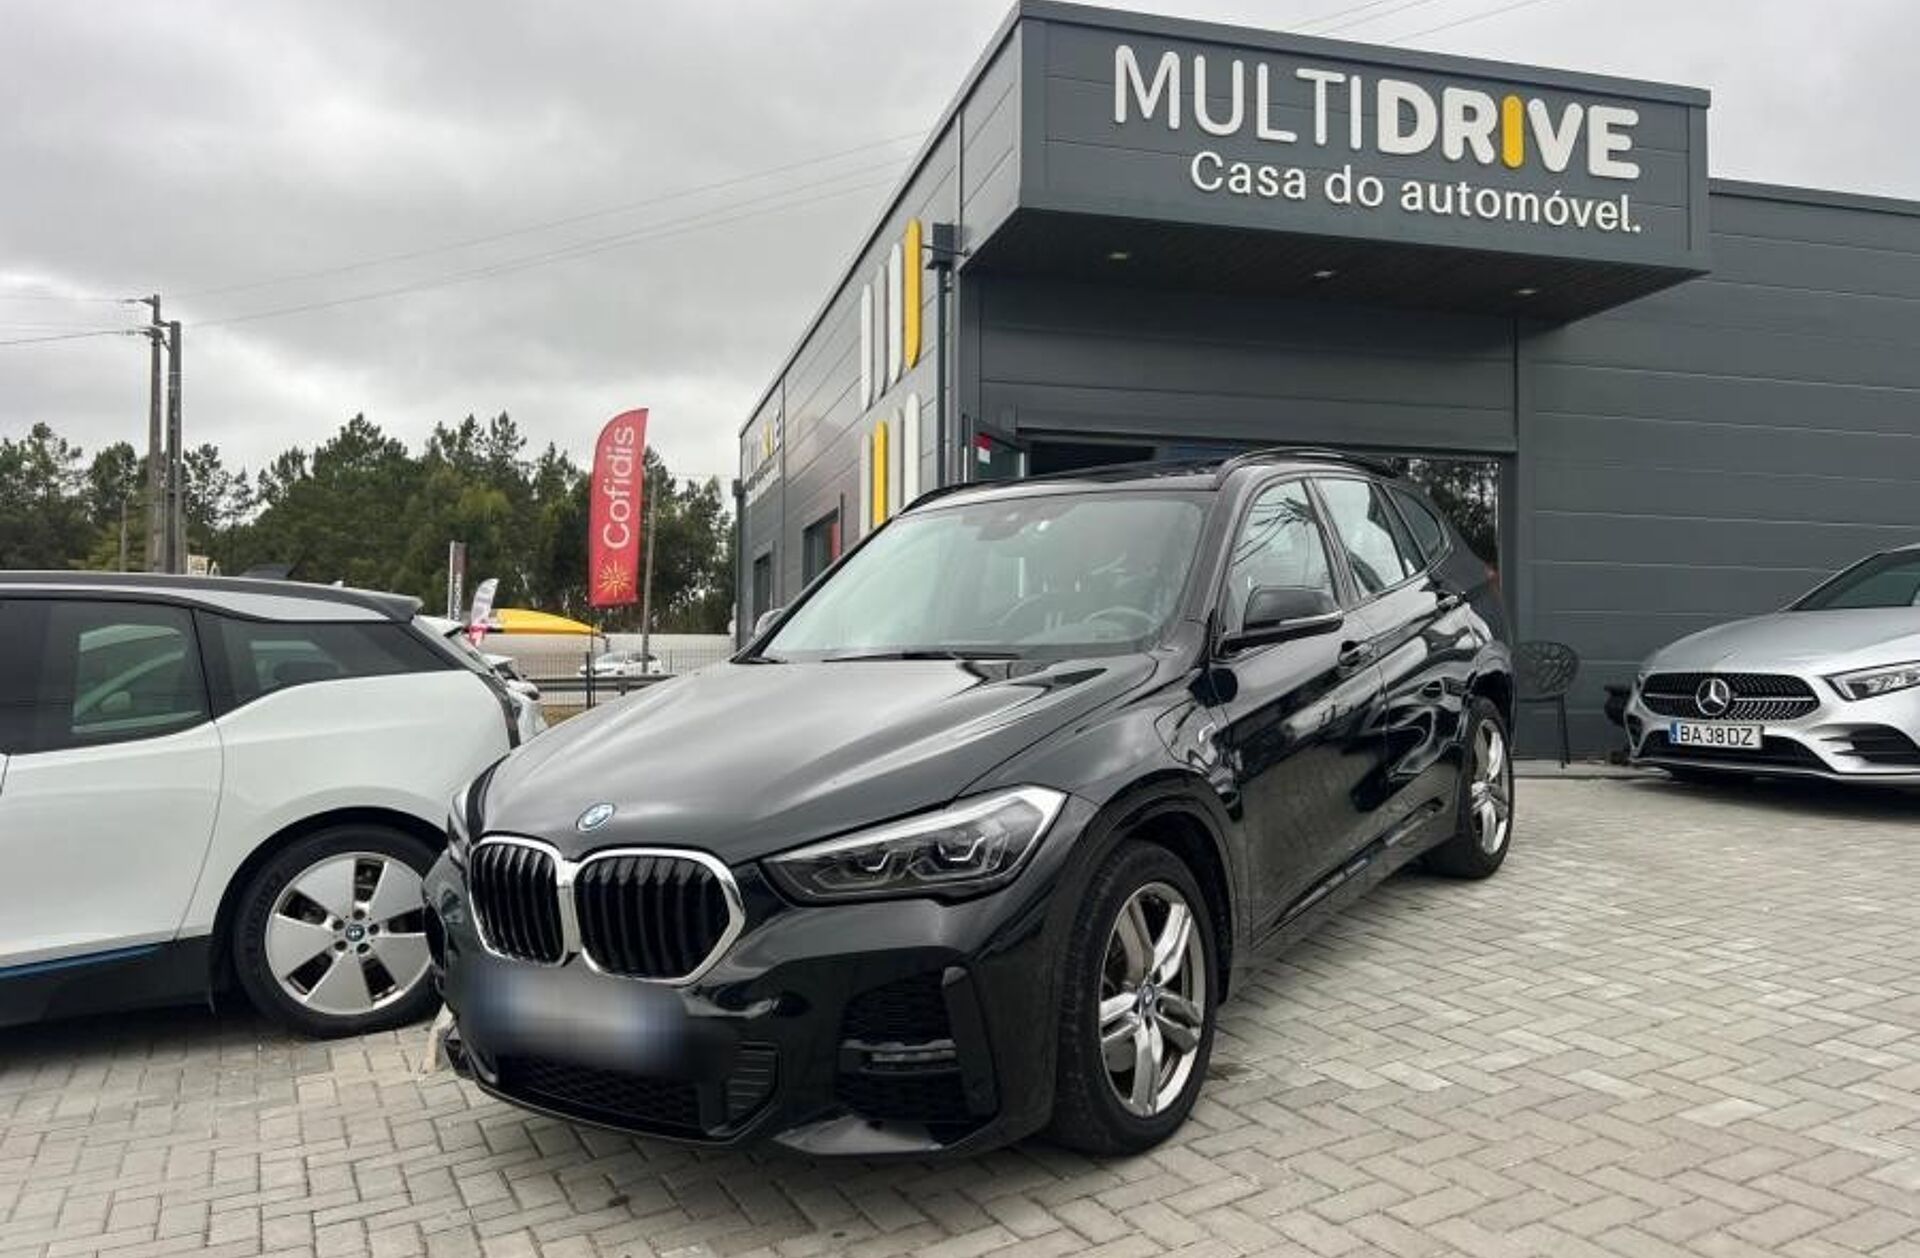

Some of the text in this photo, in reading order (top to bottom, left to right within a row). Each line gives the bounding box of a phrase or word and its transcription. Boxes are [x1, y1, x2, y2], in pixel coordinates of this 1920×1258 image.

[1113, 44, 1640, 180] MULTIDRIVE
[1190, 150, 1642, 234] Casa do automóvel.
[602, 425, 636, 550] Cofidis
[1680, 725, 1754, 746] BA 38 DZ
